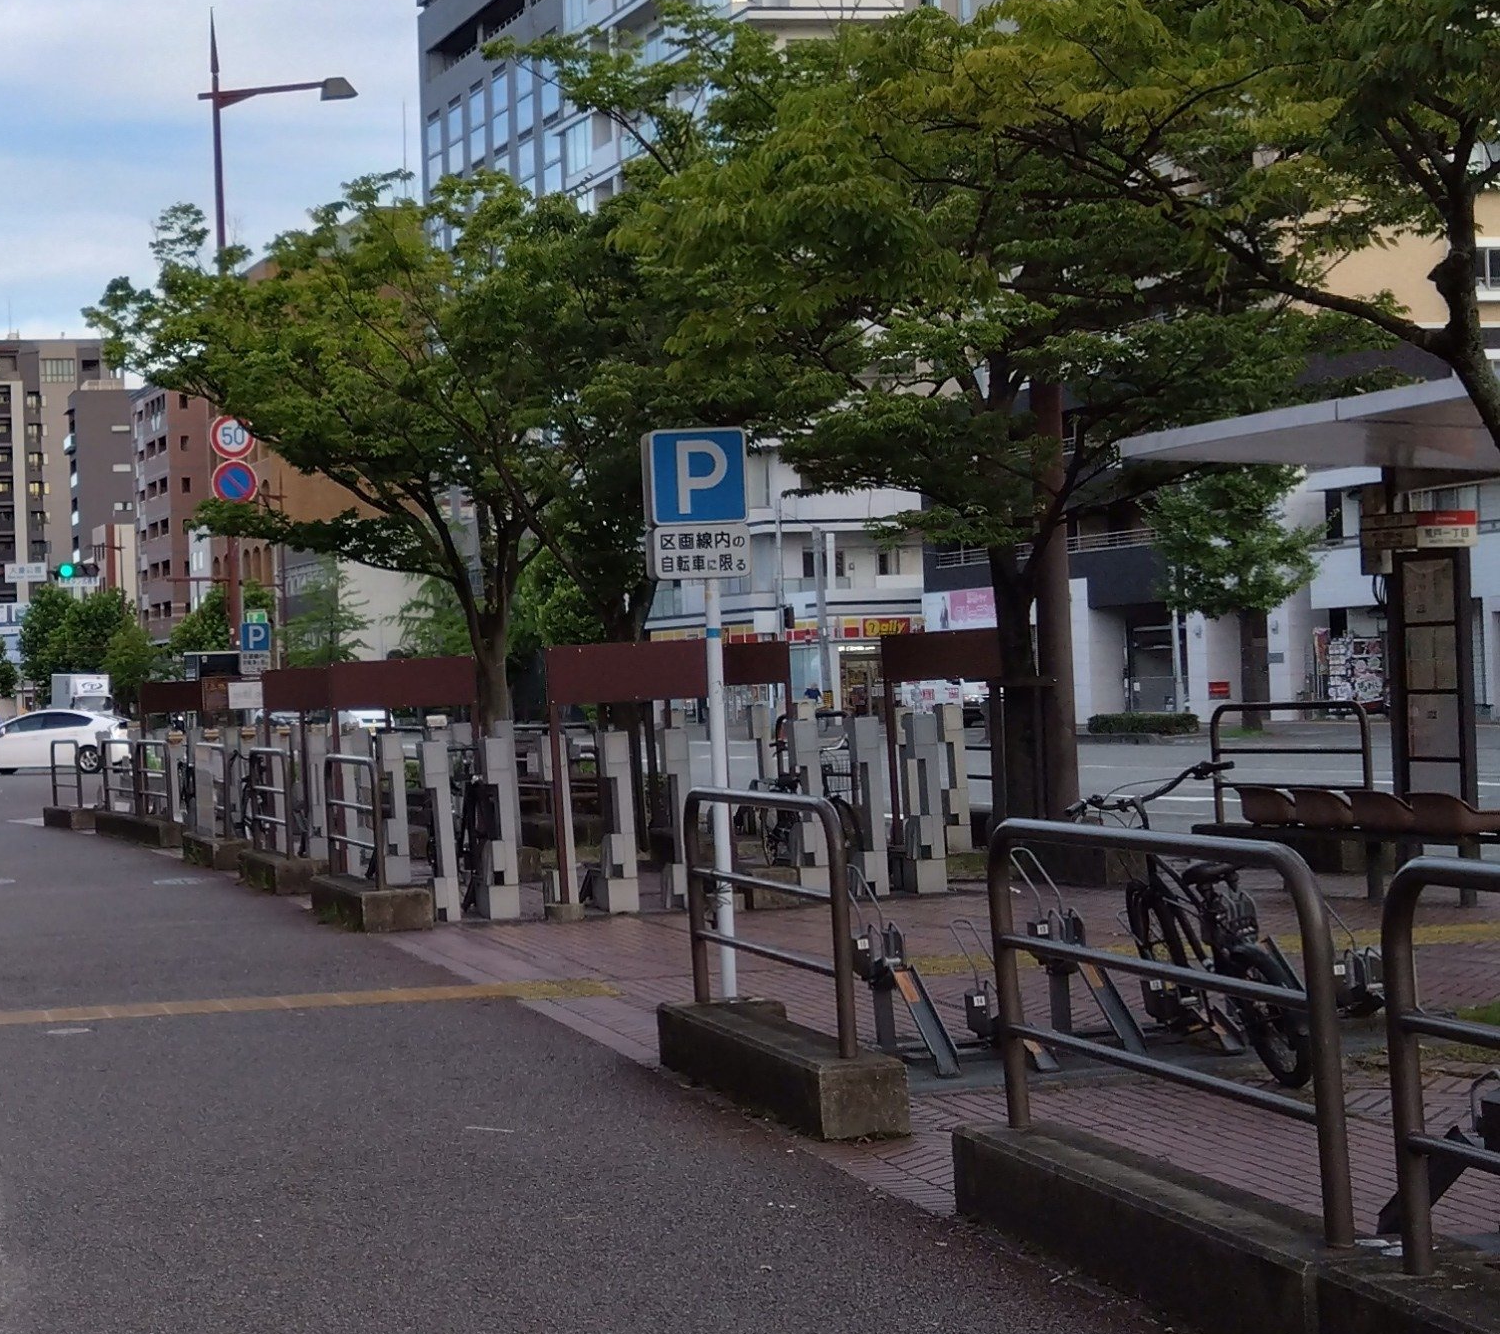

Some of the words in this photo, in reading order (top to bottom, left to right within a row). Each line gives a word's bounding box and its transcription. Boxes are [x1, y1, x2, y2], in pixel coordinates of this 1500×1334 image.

[221, 426, 245, 446] 50
[676, 439, 728, 515] P
[660, 531, 745, 551] 区画線内の
[661, 553, 746, 573] 自転車に限る
[248, 625, 266, 649] P
